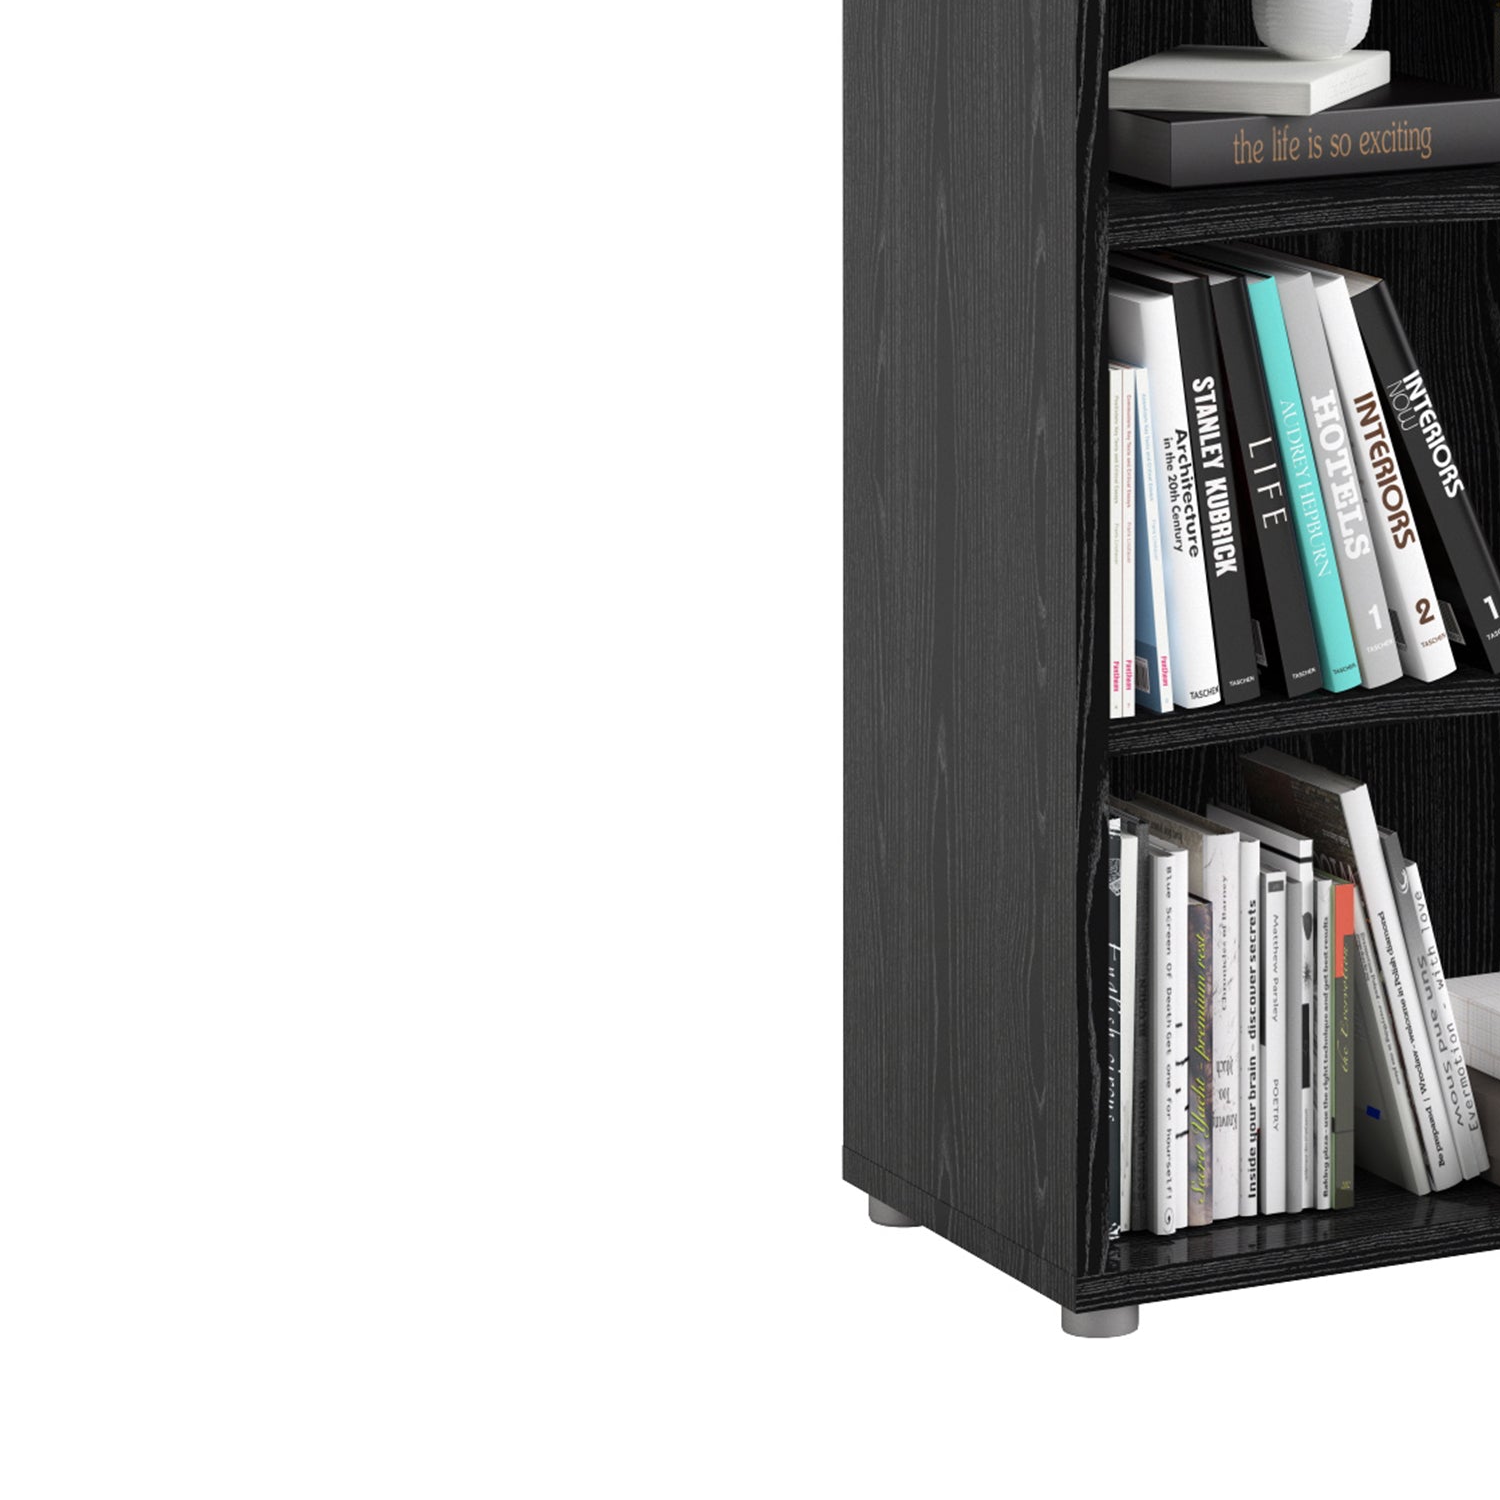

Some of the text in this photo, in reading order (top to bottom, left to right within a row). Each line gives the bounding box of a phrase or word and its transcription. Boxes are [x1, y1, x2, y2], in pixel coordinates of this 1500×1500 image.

[1233, 120, 1432, 164] the life is so exciting
[1386, 379, 1419, 431] NOW
[1402, 369, 1465, 498] INTERIORS
[1175, 428, 1199, 558] Architecture
[1191, 375, 1238, 578] STANLEY KUBRICK
[1248, 436, 1288, 529] LIFE
[1280, 399, 1332, 578] AUDREY HEPBURN
[1310, 389, 1371, 560] HOTELS
[1353, 391, 1416, 550] INTERIORS
[1163, 437, 1184, 552] in the 20th Century
[1368, 603, 1382, 630] 1
[1415, 598, 1435, 625] 2
[1482, 595, 1500, 620] 1
[1367, 638, 1394, 653] TASCHEN
[1229, 675, 1255, 686] TASCHEN
[1292, 667, 1317, 680] TASCHEN
[1332, 663, 1357, 676] TASCHEN
[1378, 911, 1393, 955] diamond
[1414, 891, 1431, 933] love
[1195, 933, 1206, 968] rest
[1389, 956, 1400, 986] Polish
[1427, 945, 1444, 991] with
[1248, 966, 1256, 1039] discover
[1396, 987, 1404, 996] in
[1194, 974, 1211, 1062] premium
[1400, 998, 1415, 1043] welcome
[1248, 1056, 1256, 1100] brain
[1446, 1022, 1480, 1131] Evermotion
[1191, 1076, 1210, 1140] Yacht
[1249, 1104, 1258, 1142] your
[1424, 1106, 1443, 1152] prepared
[1191, 1144, 1206, 1204] Secret
[1248, 1148, 1256, 1198] Inside
[1435, 1153, 1445, 1167] Be
